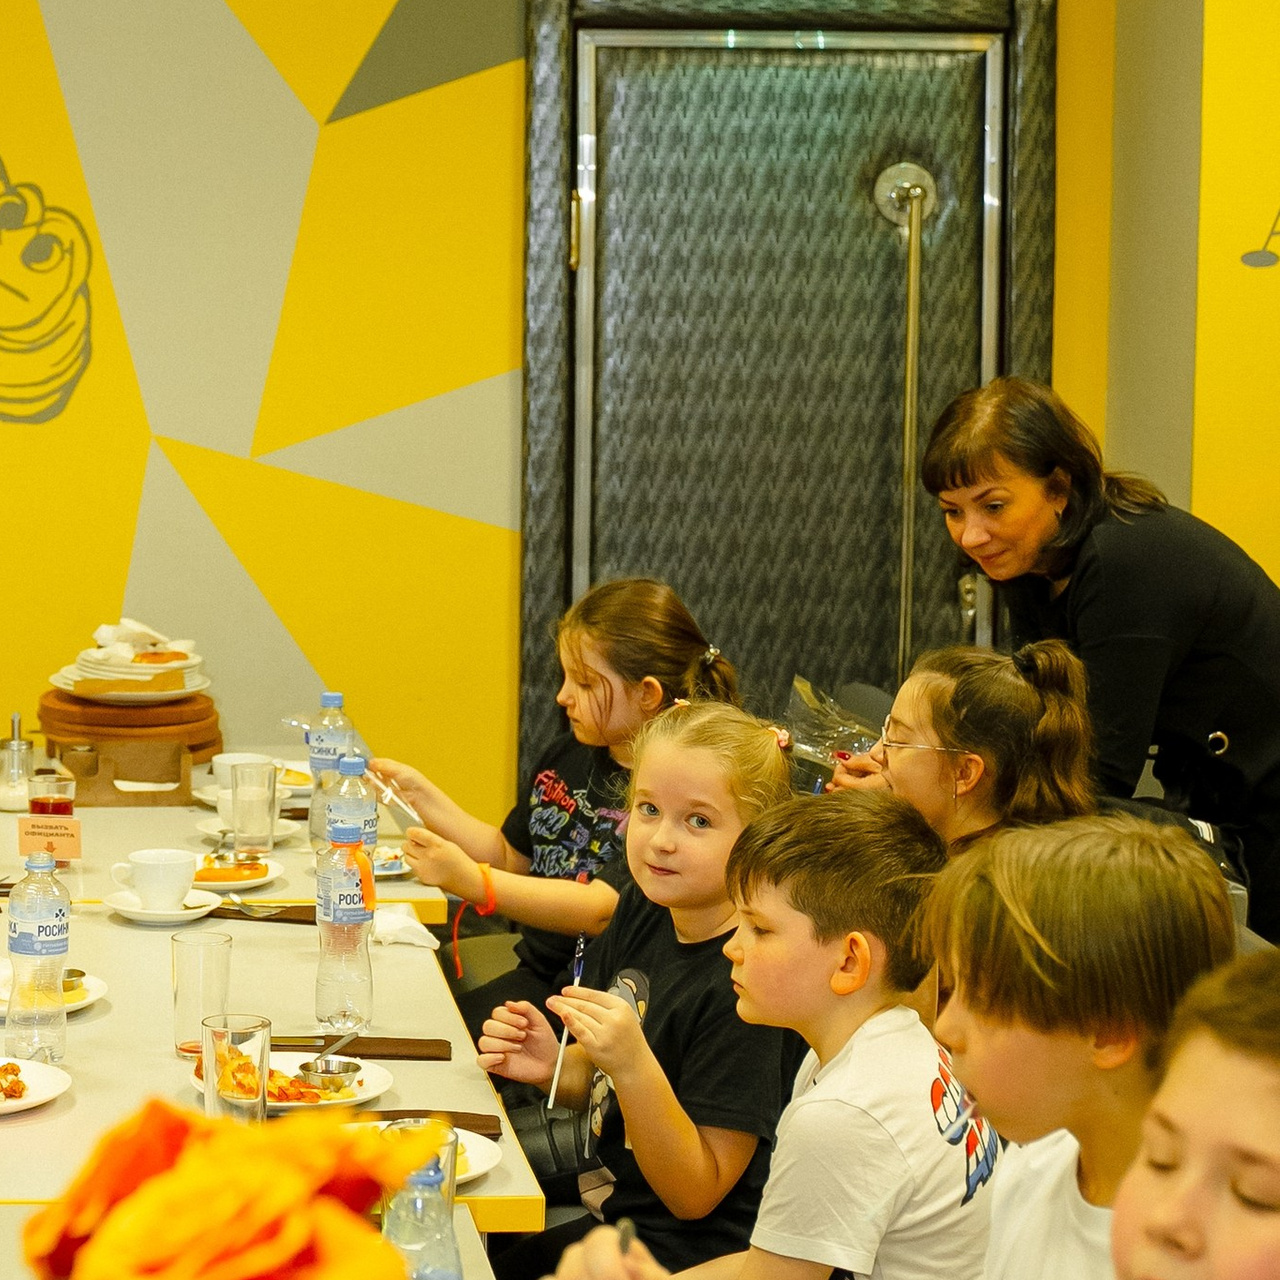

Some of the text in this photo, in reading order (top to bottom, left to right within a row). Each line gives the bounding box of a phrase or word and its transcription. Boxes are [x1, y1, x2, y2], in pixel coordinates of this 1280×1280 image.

[31, 823, 70, 831] ВЫЗВАТЬ
[24, 830, 75, 839] ОФИЦИАНТА
[338, 893, 365, 906] РОСИ
[37, 922, 69, 937] РОСИН
